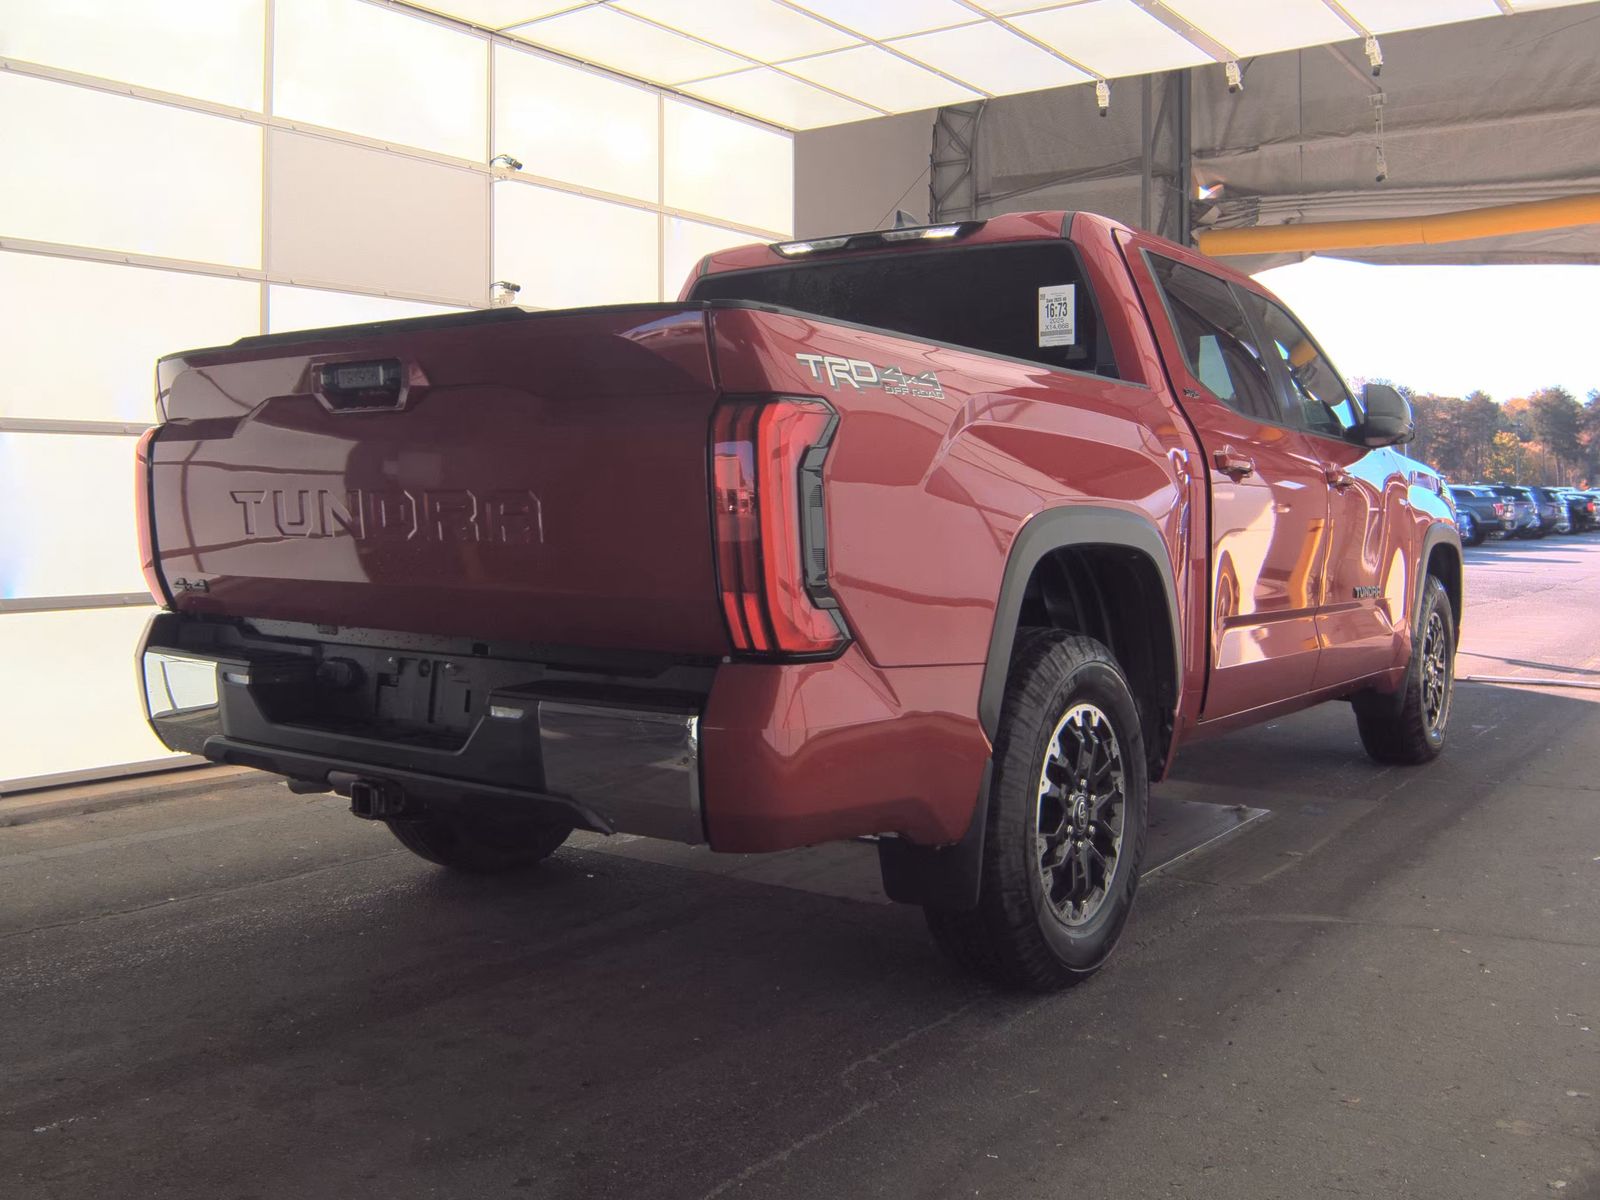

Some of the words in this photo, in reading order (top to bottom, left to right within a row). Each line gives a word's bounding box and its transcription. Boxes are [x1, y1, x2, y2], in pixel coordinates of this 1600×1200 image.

[1045, 302, 1068, 318] 16:73
[795, 353, 880, 391] TRD
[229, 489, 544, 542] TUNDRA
